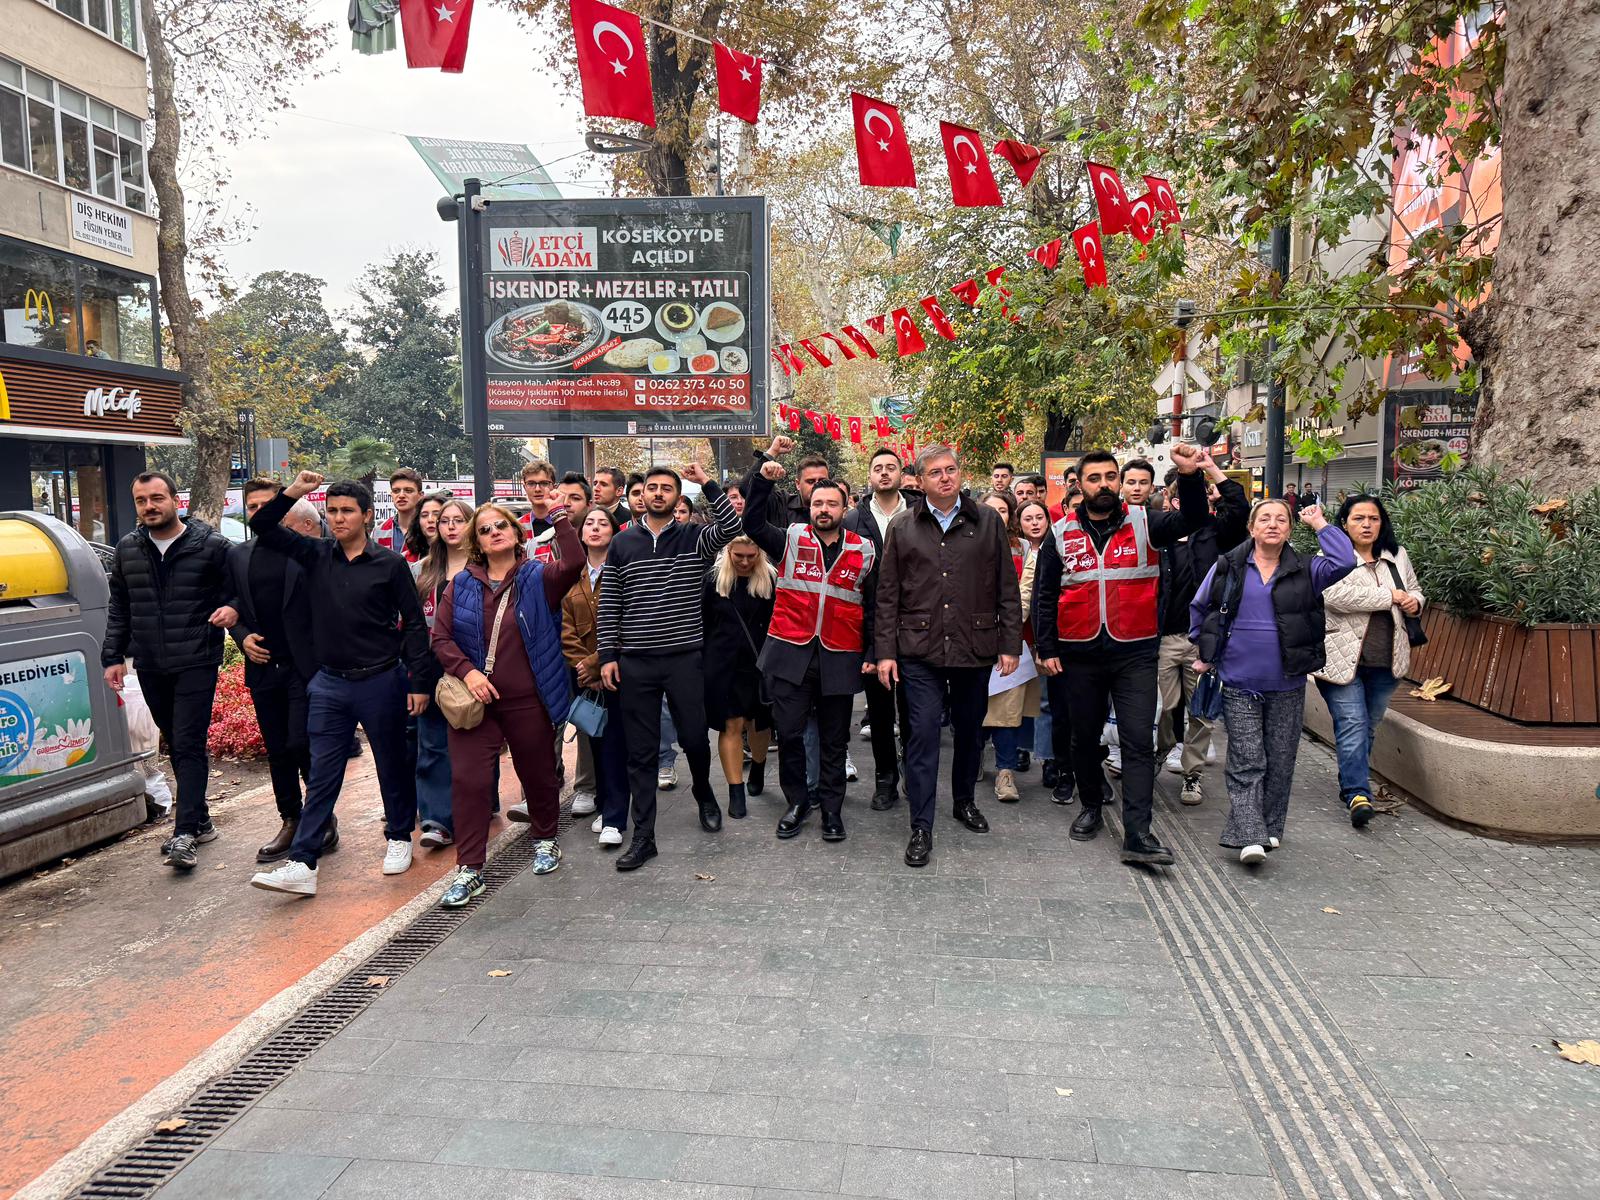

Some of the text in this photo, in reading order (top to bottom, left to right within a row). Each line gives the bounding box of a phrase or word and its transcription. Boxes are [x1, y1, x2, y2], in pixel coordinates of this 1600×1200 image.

[77, 202, 127, 229] DİŞ HEKİMİ
[83, 219, 123, 241] FÜSUN YENER
[602, 225, 724, 244] KÖSEKÖY'DE
[539, 232, 584, 254] ETÇİ
[530, 252, 593, 267] ADAM
[631, 250, 694, 267] AÇILDI
[606, 307, 645, 324] 445
[623, 324, 633, 332] TL
[596, 379, 621, 387] No:89
[649, 379, 745, 390] 0262 373 40 50
[488, 398, 523, 407] Köseköy
[530, 397, 566, 406] KOCAELİ
[649, 395, 746, 405] 0532 204 76 80
[1424, 414, 1448, 422] DAM
[1448, 440, 1468, 449] 445
[0, 660, 70, 686] BELEDİYESİ
